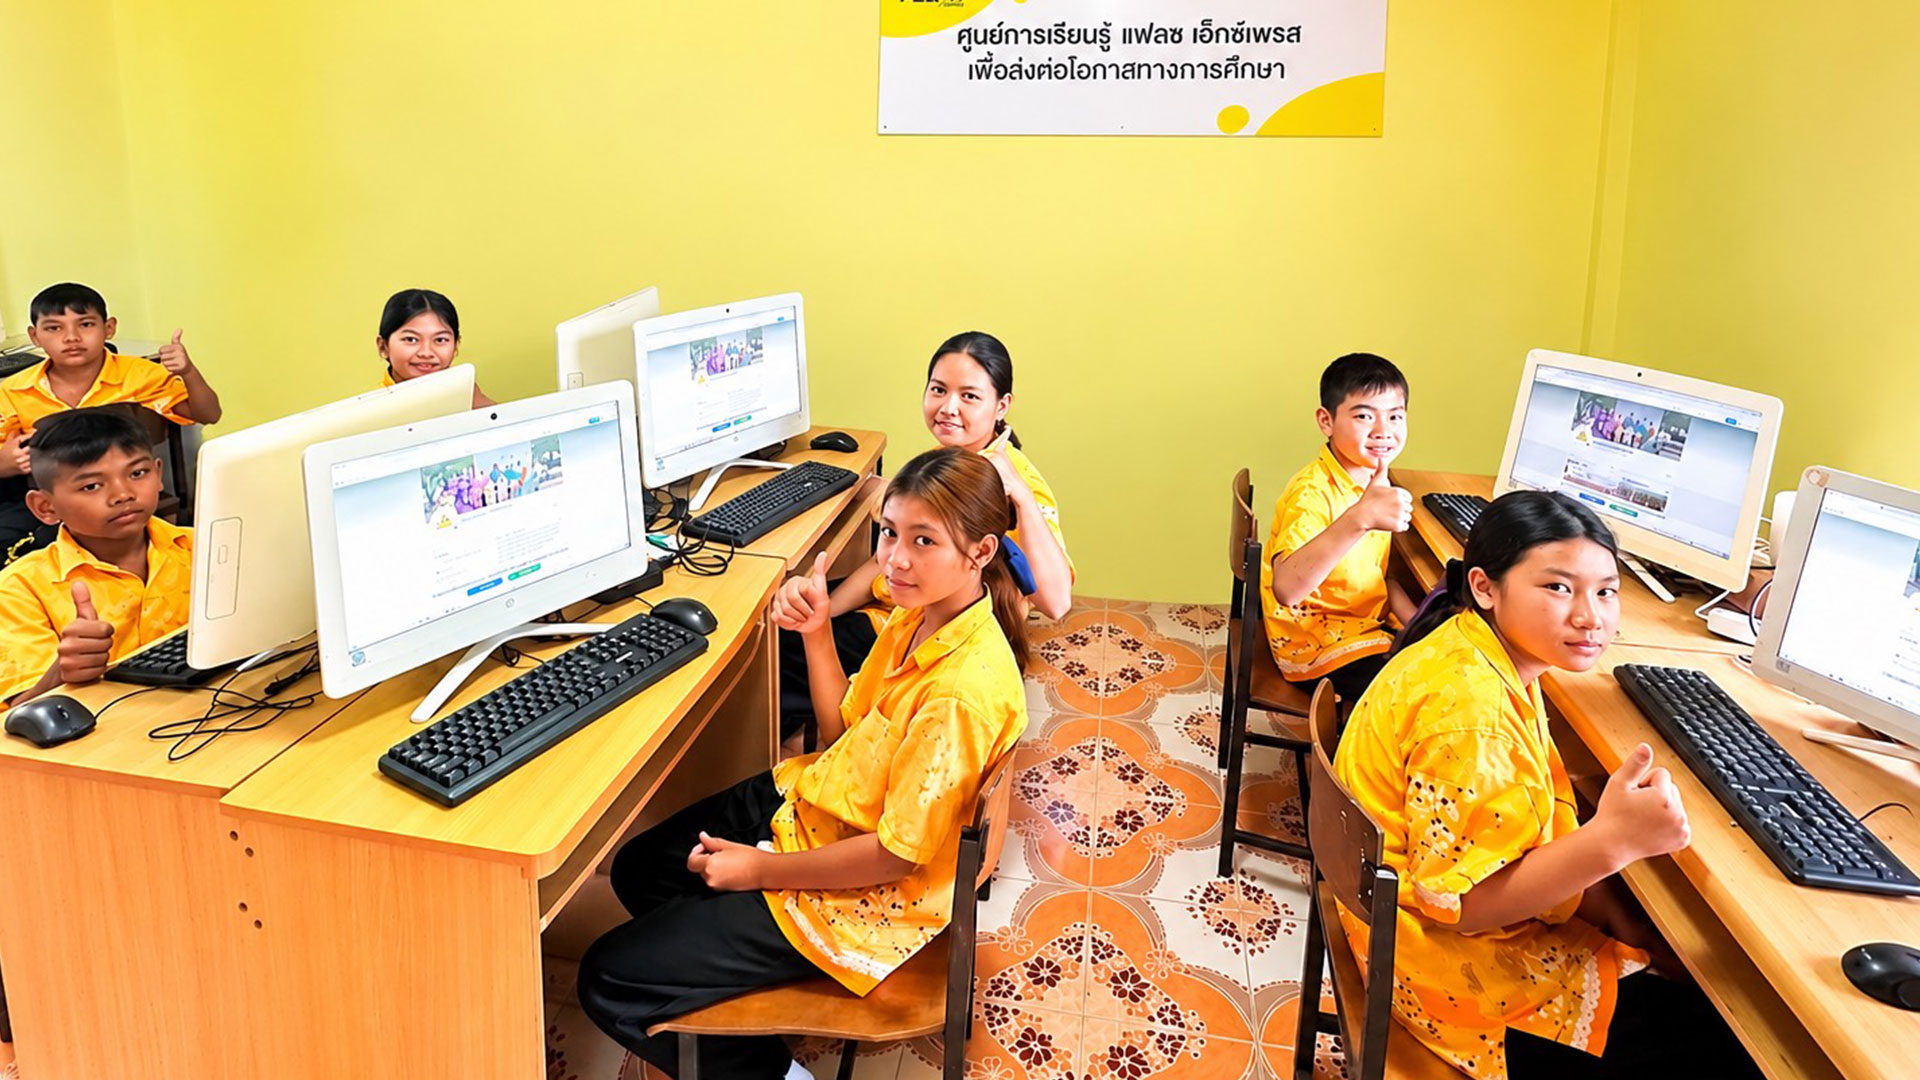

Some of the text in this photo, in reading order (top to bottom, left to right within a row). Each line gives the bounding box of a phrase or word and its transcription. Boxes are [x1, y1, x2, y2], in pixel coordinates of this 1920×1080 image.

[957, 20, 1112, 53] ศูนย์การเรียนรู้
